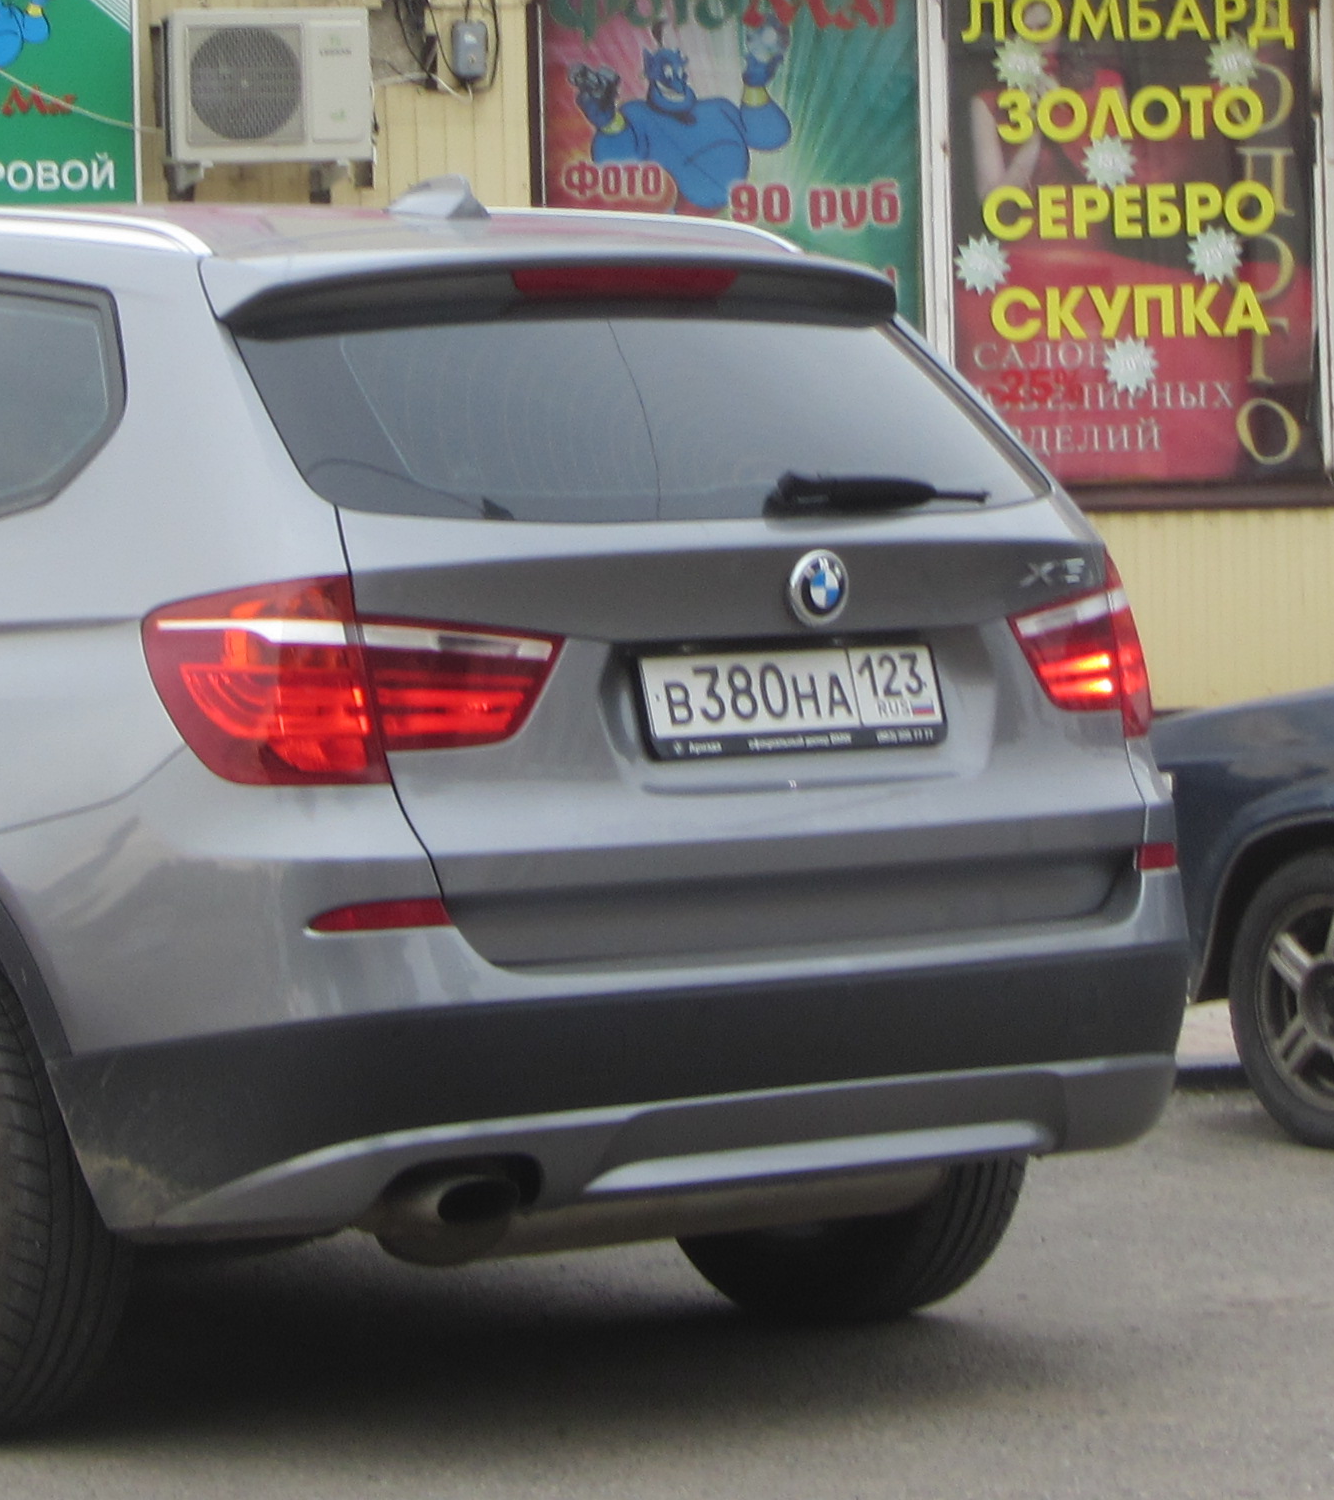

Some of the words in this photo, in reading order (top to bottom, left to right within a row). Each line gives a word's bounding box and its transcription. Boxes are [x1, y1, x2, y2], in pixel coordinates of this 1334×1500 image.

[997, 85, 1264, 144] ЗОЛОТО
[730, 183, 792, 225] 90
[809, 179, 901, 231] руб
[983, 180, 1275, 241] СЕРЕБРО
[991, 282, 1271, 342] СКУПКА
[666, 662, 853, 727] В380НА
[858, 652, 925, 699] 123
[876, 701, 911, 717] RUS
